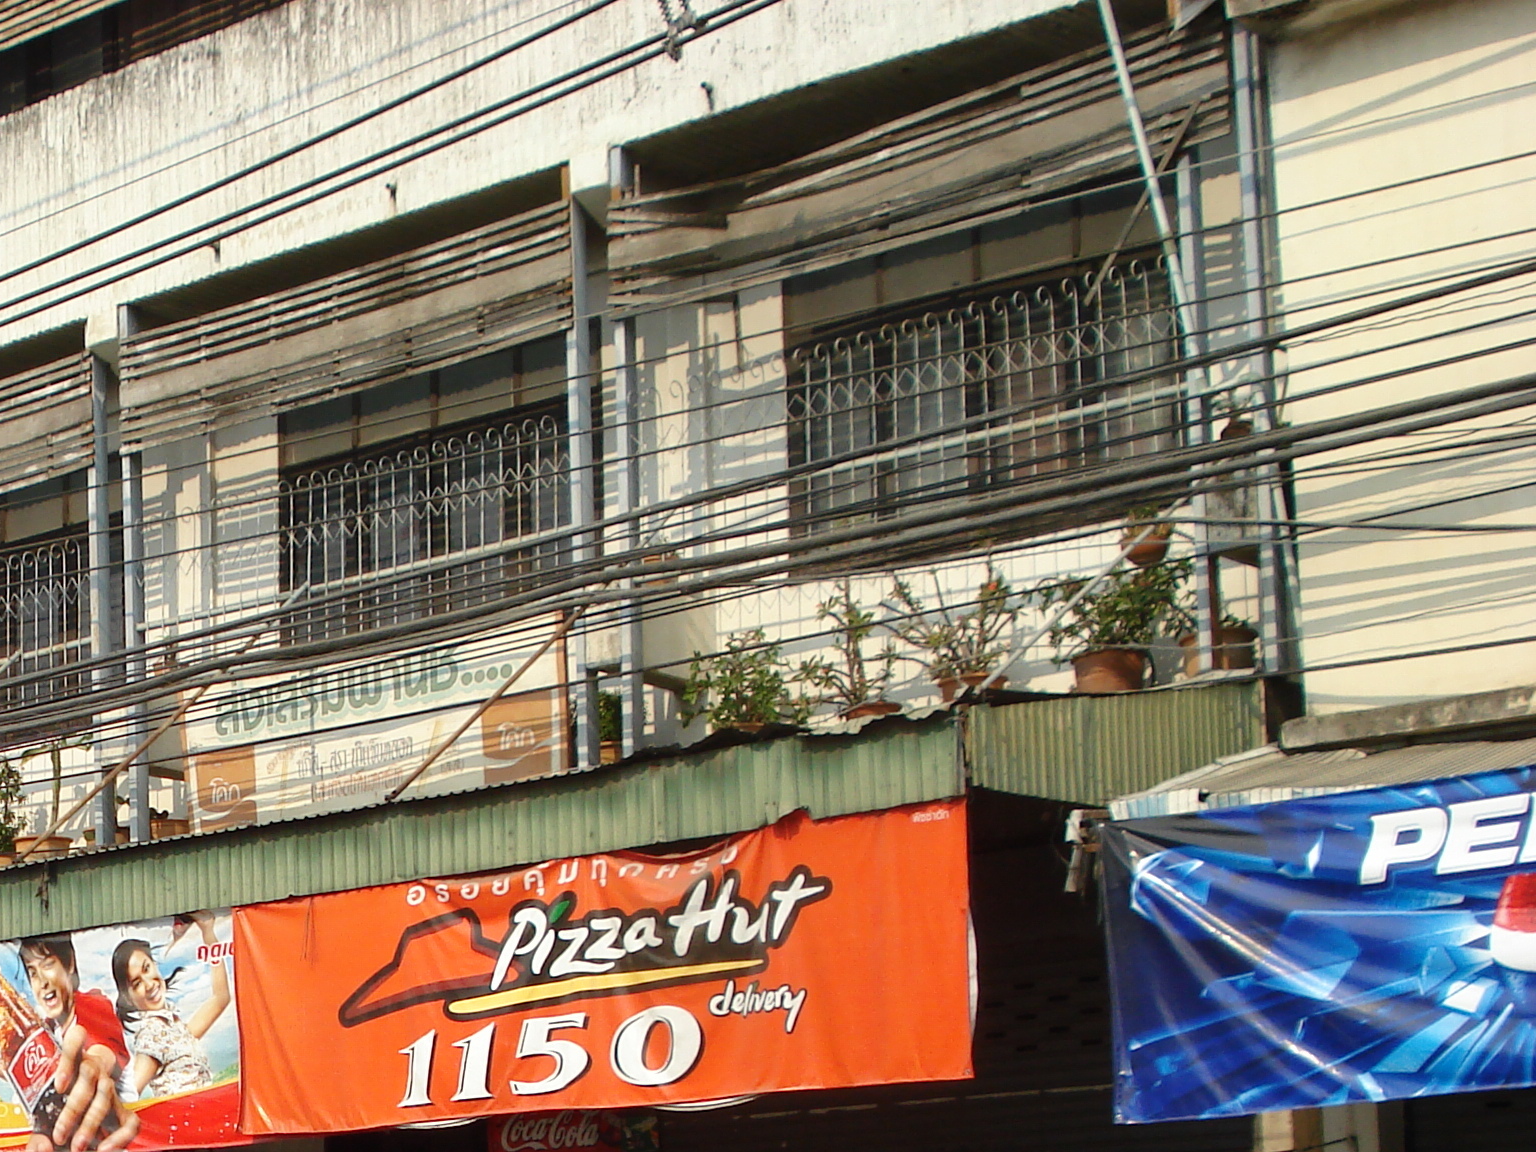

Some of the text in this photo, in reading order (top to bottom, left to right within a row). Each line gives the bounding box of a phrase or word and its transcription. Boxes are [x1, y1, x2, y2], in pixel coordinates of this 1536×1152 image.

[1360, 794, 1536, 885] PE
[490, 873, 826, 992] Pizza Hut
[396, 1003, 704, 1108] 1150
[710, 983, 807, 1034] delivery
